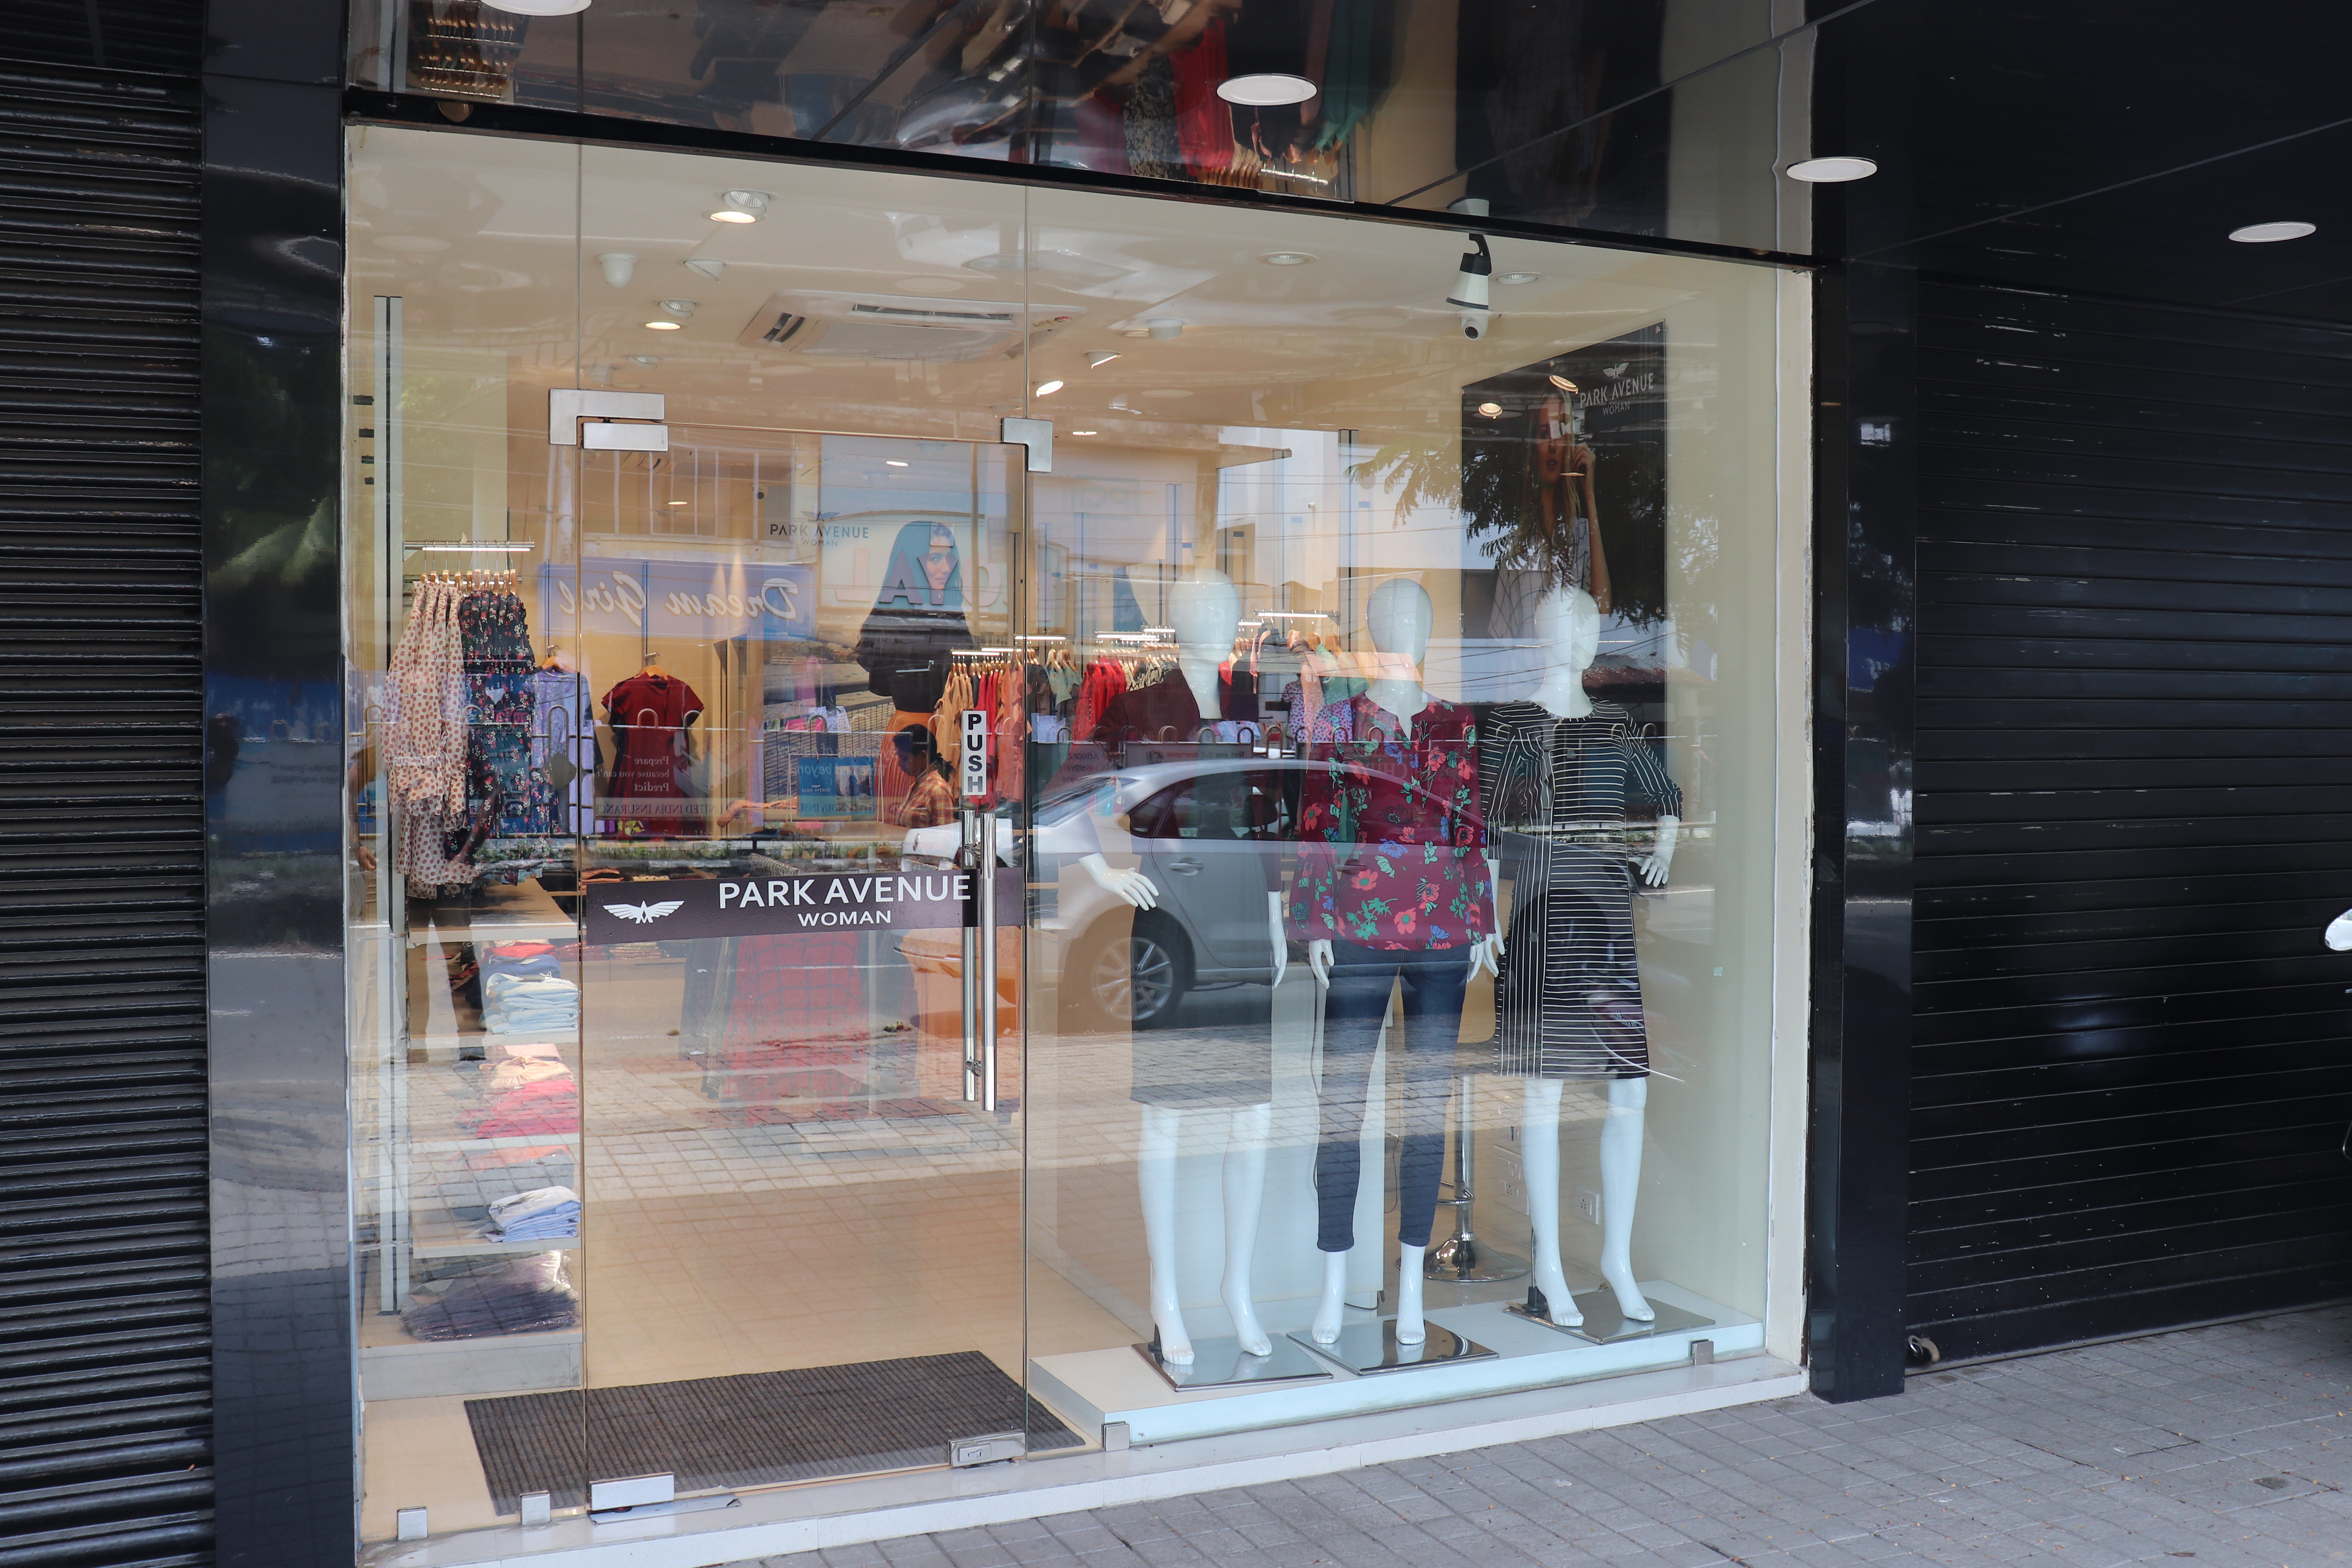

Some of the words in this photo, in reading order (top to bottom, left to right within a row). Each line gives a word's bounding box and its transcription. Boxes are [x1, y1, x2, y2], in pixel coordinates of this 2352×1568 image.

[1580, 386, 1608, 408] PARK
[1612, 372, 1654, 400] AVENUE
[1602, 401, 1630, 416] WOMAN
[770, 524, 808, 537] PARK
[816, 525, 869, 539] AVENUE
[801, 539, 838, 547] WOMAN
[967, 713, 984, 793] PUSH
[719, 879, 816, 909] PARK
[824, 875, 971, 905] AVENUE
[797, 910, 891, 927] WOMAN
